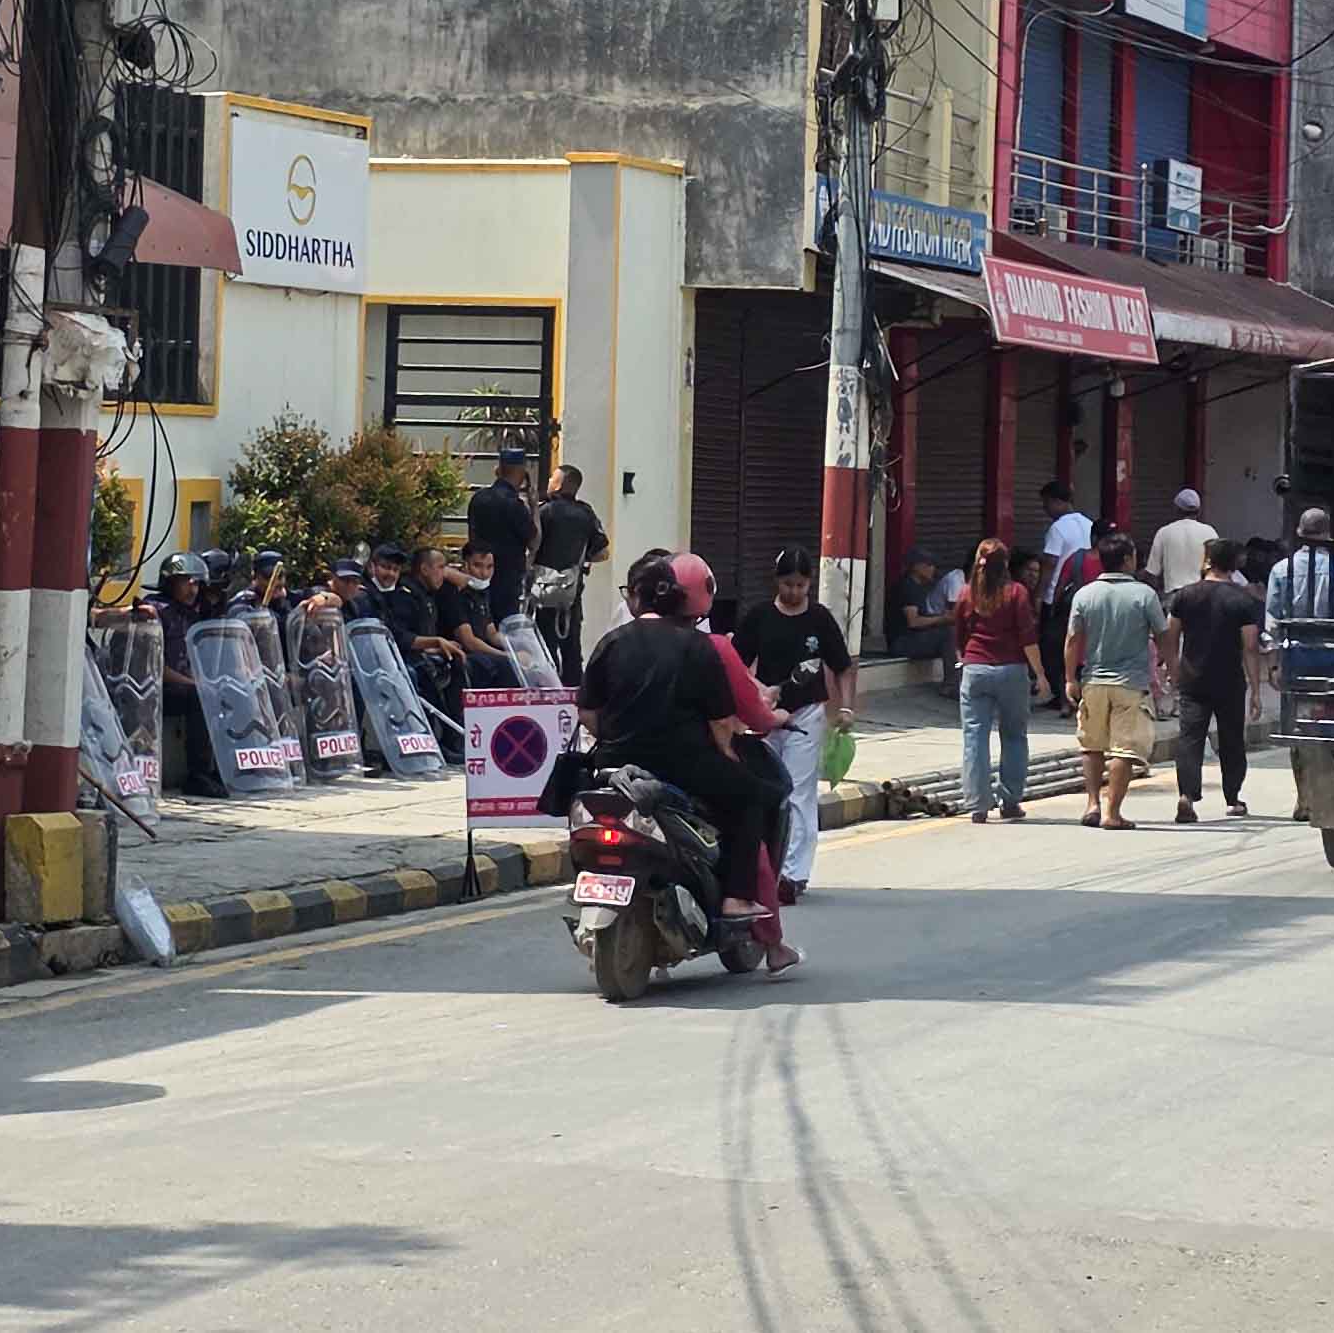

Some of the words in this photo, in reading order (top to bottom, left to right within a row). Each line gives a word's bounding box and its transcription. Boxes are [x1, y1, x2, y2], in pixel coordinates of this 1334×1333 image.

[245, 228, 355, 269] SIDDHARTHA
[892, 202, 941, 257] FASHION
[942, 214, 974, 266] WEAR
[1004, 272, 1064, 323] DIAMOND
[1063, 285, 1115, 331] FASHION
[1112, 295, 1149, 337] WEAR
[238, 749, 283, 768] POLICE
[319, 735, 358, 756] POLICE
[118, 772, 145, 792] POL
